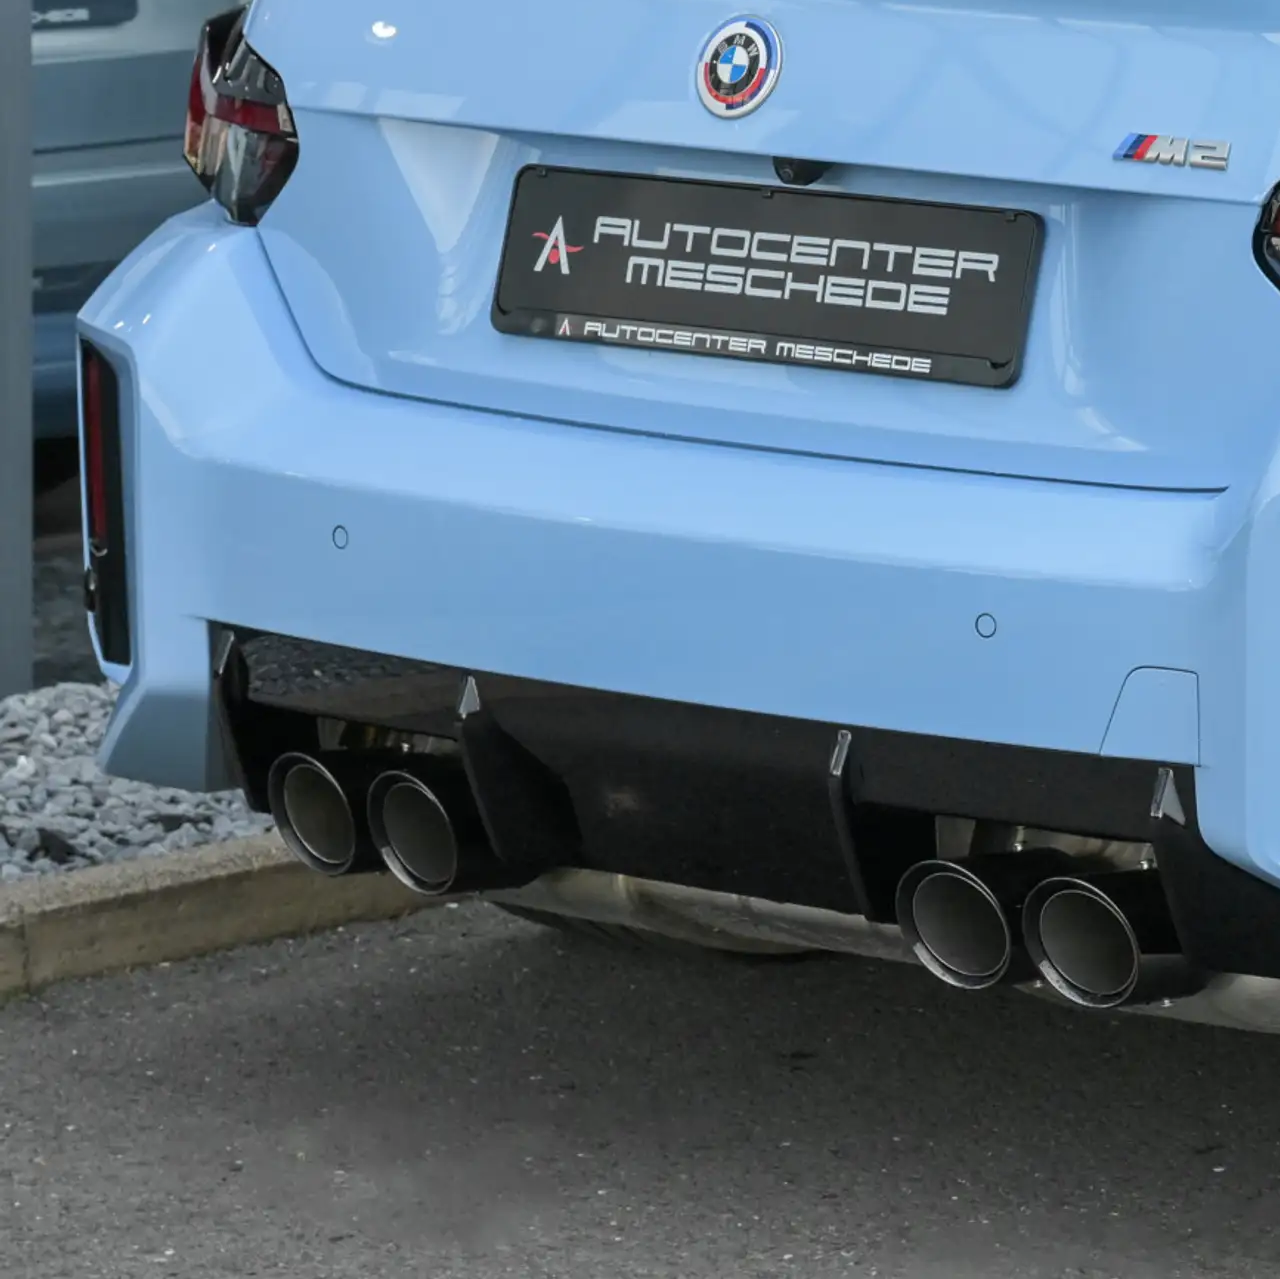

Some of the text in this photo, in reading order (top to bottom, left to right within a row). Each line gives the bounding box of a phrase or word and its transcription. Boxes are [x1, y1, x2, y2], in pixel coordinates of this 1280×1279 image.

[717, 34, 759, 57] BMW
[1142, 134, 1232, 172] M2
[592, 214, 1000, 283] AUTOCENTER
[624, 255, 951, 316] MESCHEDE
[583, 320, 933, 374] AUTOCENTER MESCHEDE
